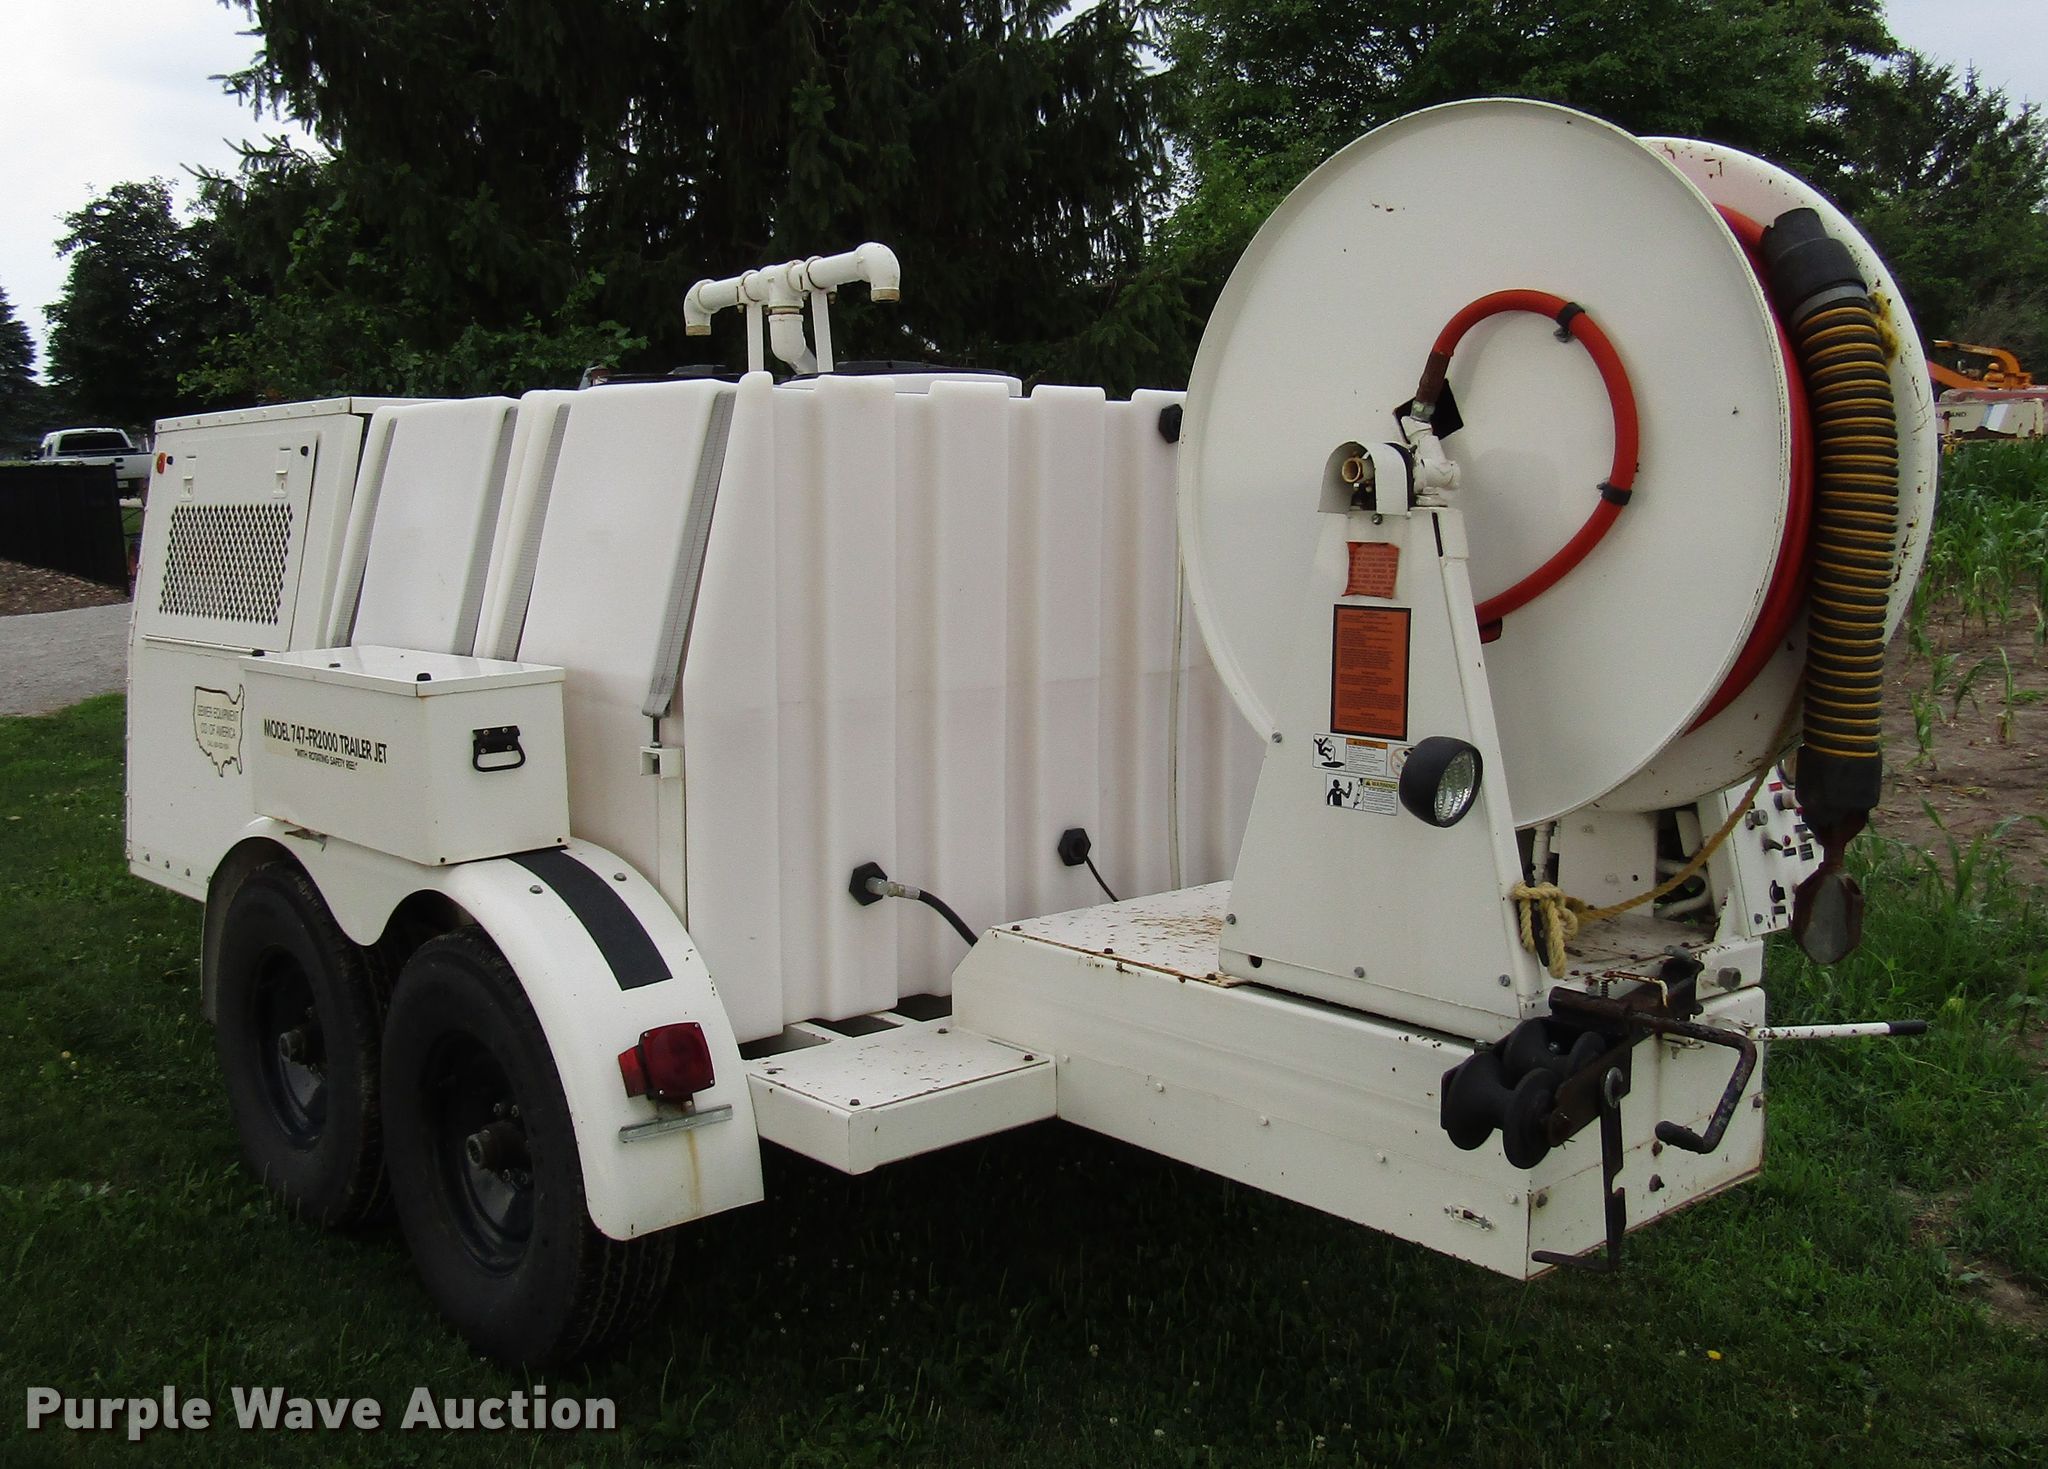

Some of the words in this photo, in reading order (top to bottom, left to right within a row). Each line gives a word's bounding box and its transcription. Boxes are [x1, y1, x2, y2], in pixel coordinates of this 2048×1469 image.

[263, 719, 291, 742] MODEL
[291, 724, 338, 753] 747-FR2000
[339, 734, 372, 760] TRAILER
[374, 742, 387, 764] JET
[330, 756, 345, 768] SAFETY
